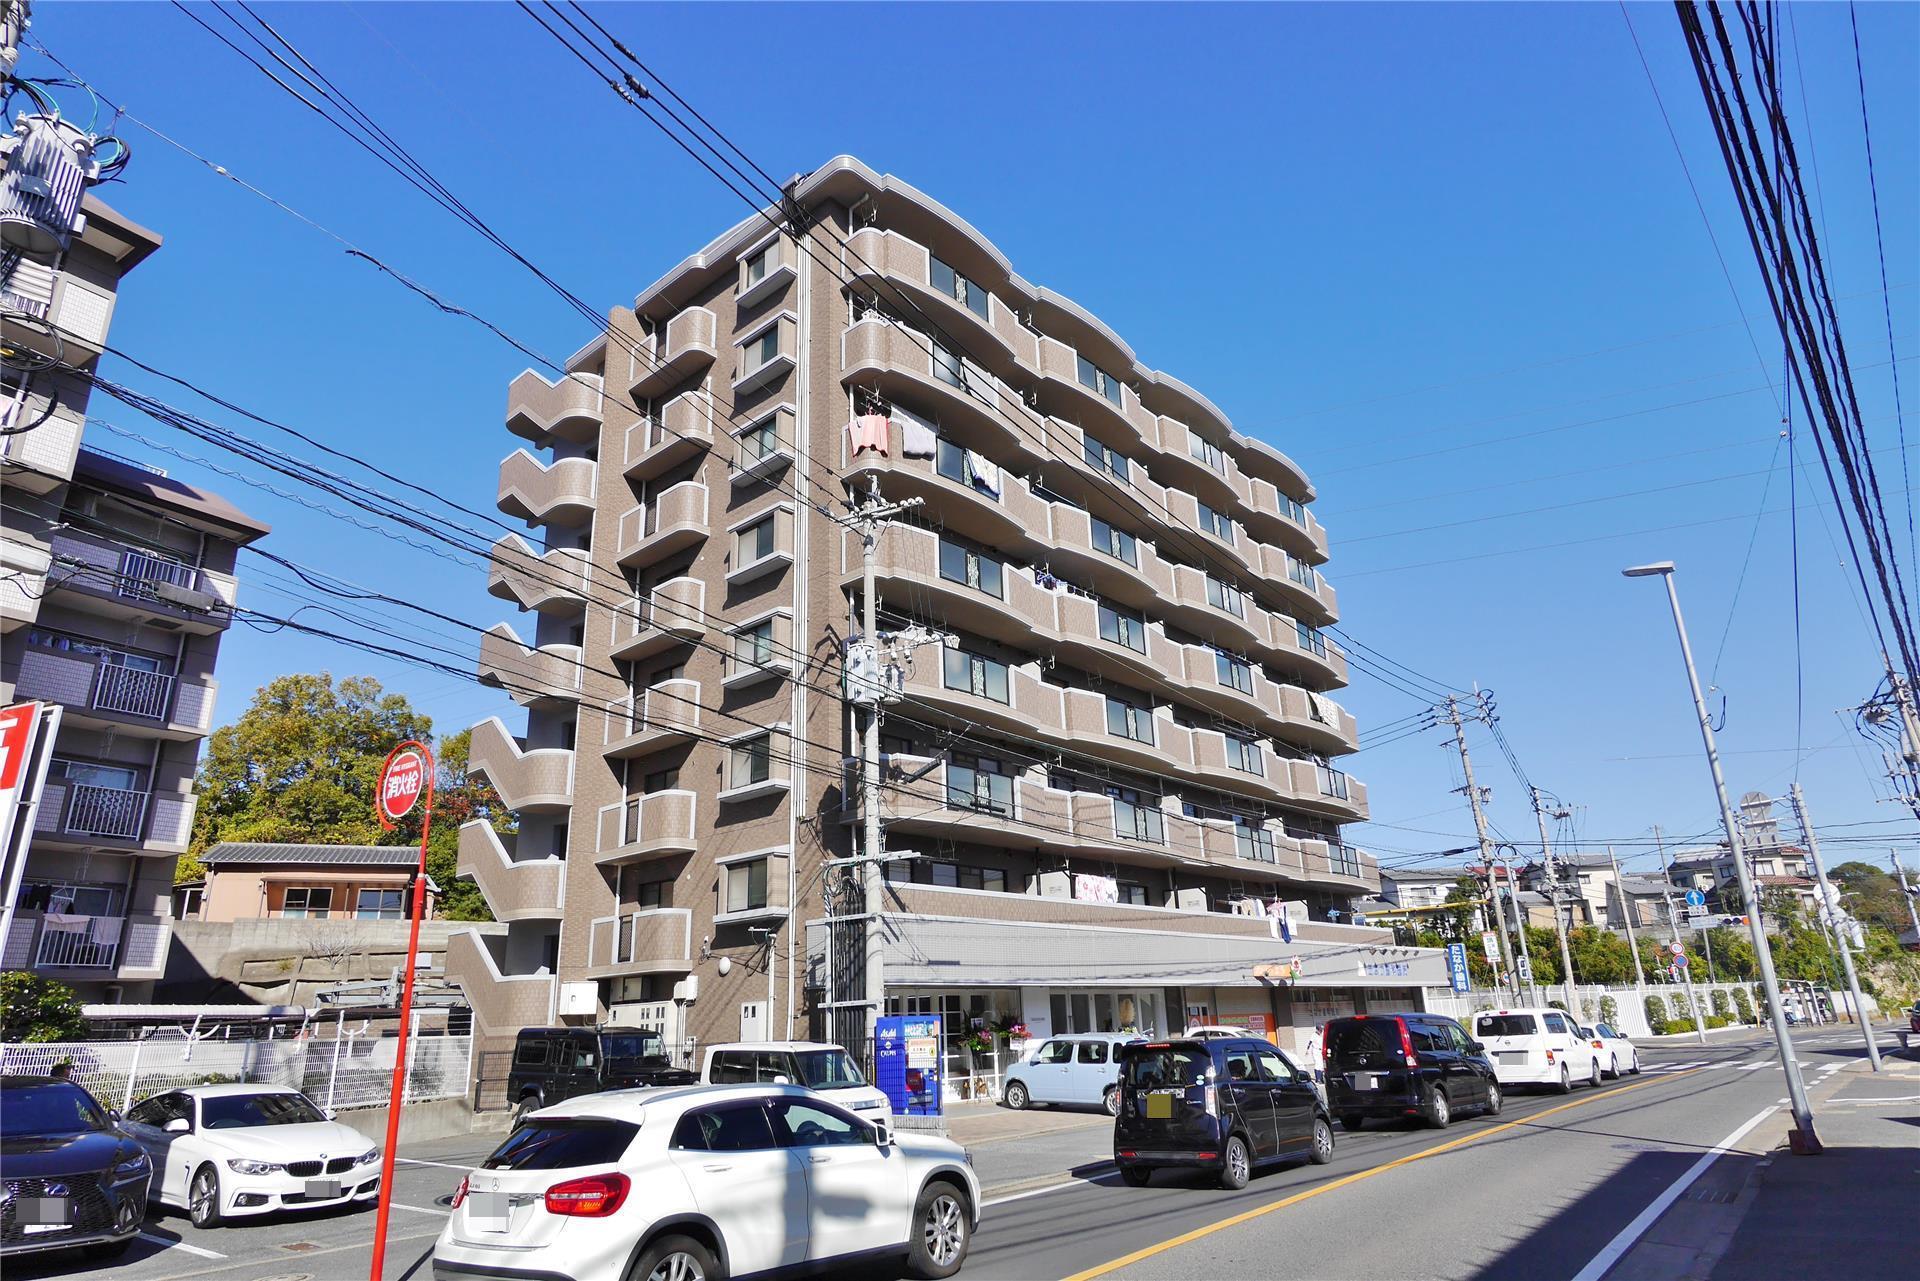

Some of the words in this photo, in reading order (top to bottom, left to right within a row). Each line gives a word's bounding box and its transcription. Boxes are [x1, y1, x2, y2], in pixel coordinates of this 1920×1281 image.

[386, 770, 418, 799] 消火栓
[1451, 945, 1467, 991] たなか歯科
